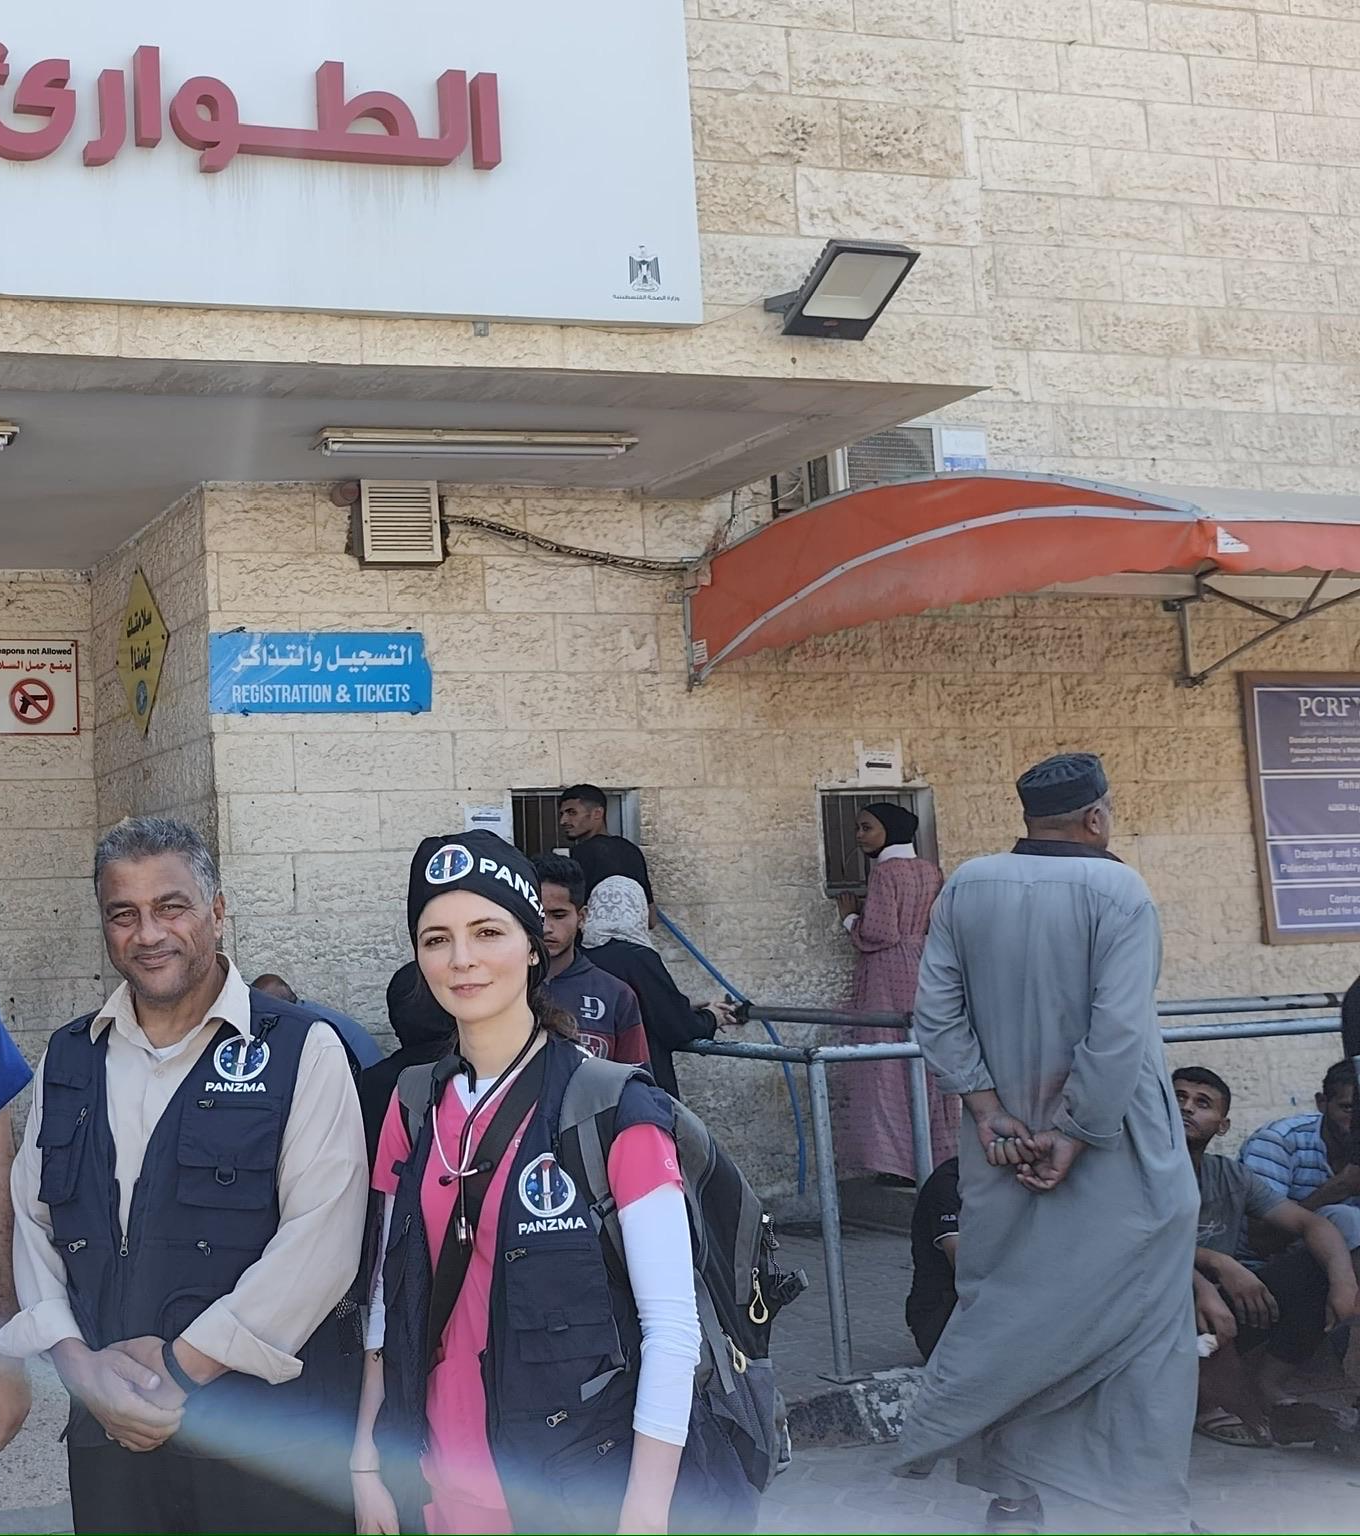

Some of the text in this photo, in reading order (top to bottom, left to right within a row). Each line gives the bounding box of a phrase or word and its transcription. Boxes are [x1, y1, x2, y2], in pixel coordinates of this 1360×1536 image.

[25, 660, 46, 671] حمل
[231, 643, 413, 673] التسجيل والتذاكر
[49, 660, 72, 673] يمنع
[232, 684, 410, 704] REGISTRATION & TICKETS
[1298, 696, 1351, 717] PCRF
[1294, 849, 1333, 860] Designed
[1335, 848, 1350, 858] and
[1280, 863, 1327, 873] Palestinian
[479, 857, 546, 918] PANZ
[205, 1081, 266, 1092] PANZMA
[518, 1217, 587, 1235] PANZMA
